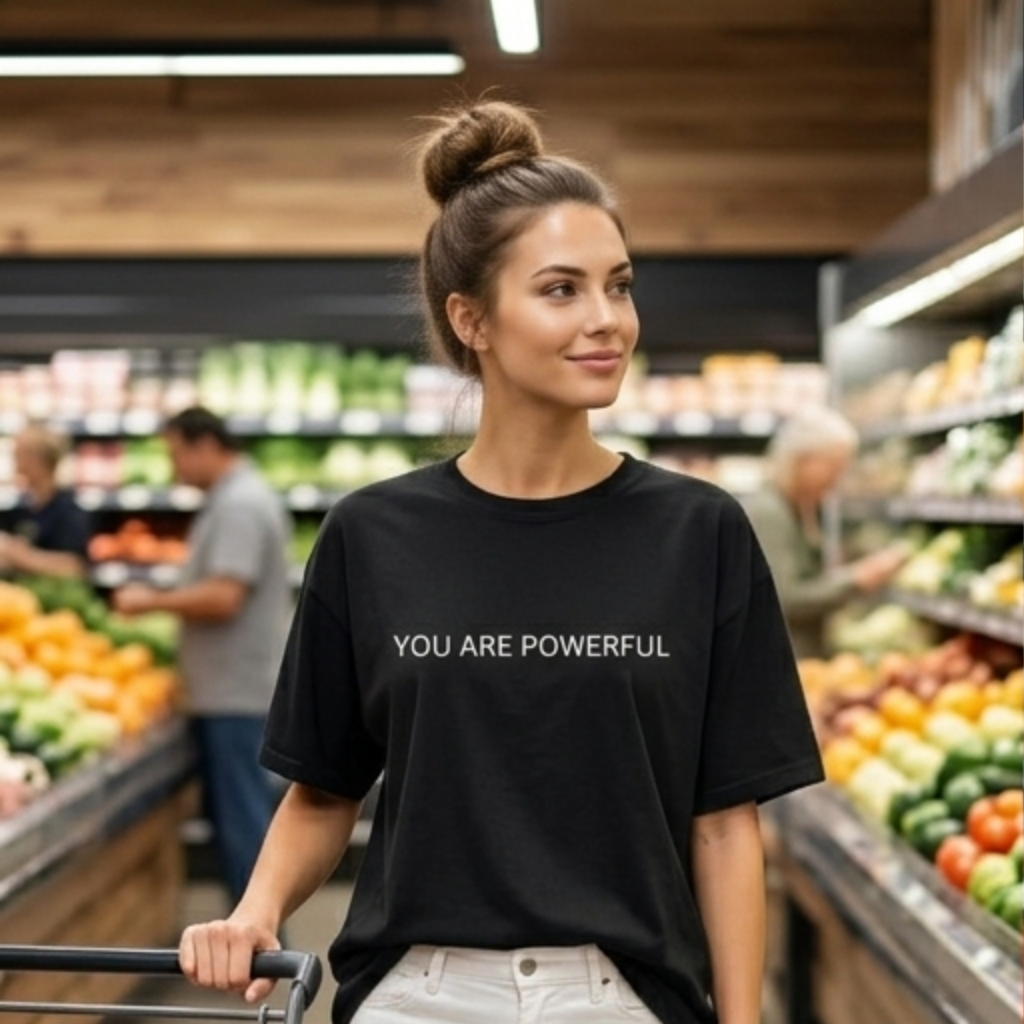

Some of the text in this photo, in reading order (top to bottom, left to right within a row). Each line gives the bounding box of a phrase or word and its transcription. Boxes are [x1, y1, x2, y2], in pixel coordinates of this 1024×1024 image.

[393, 634, 671, 657] YOU ARE POWERFUL
